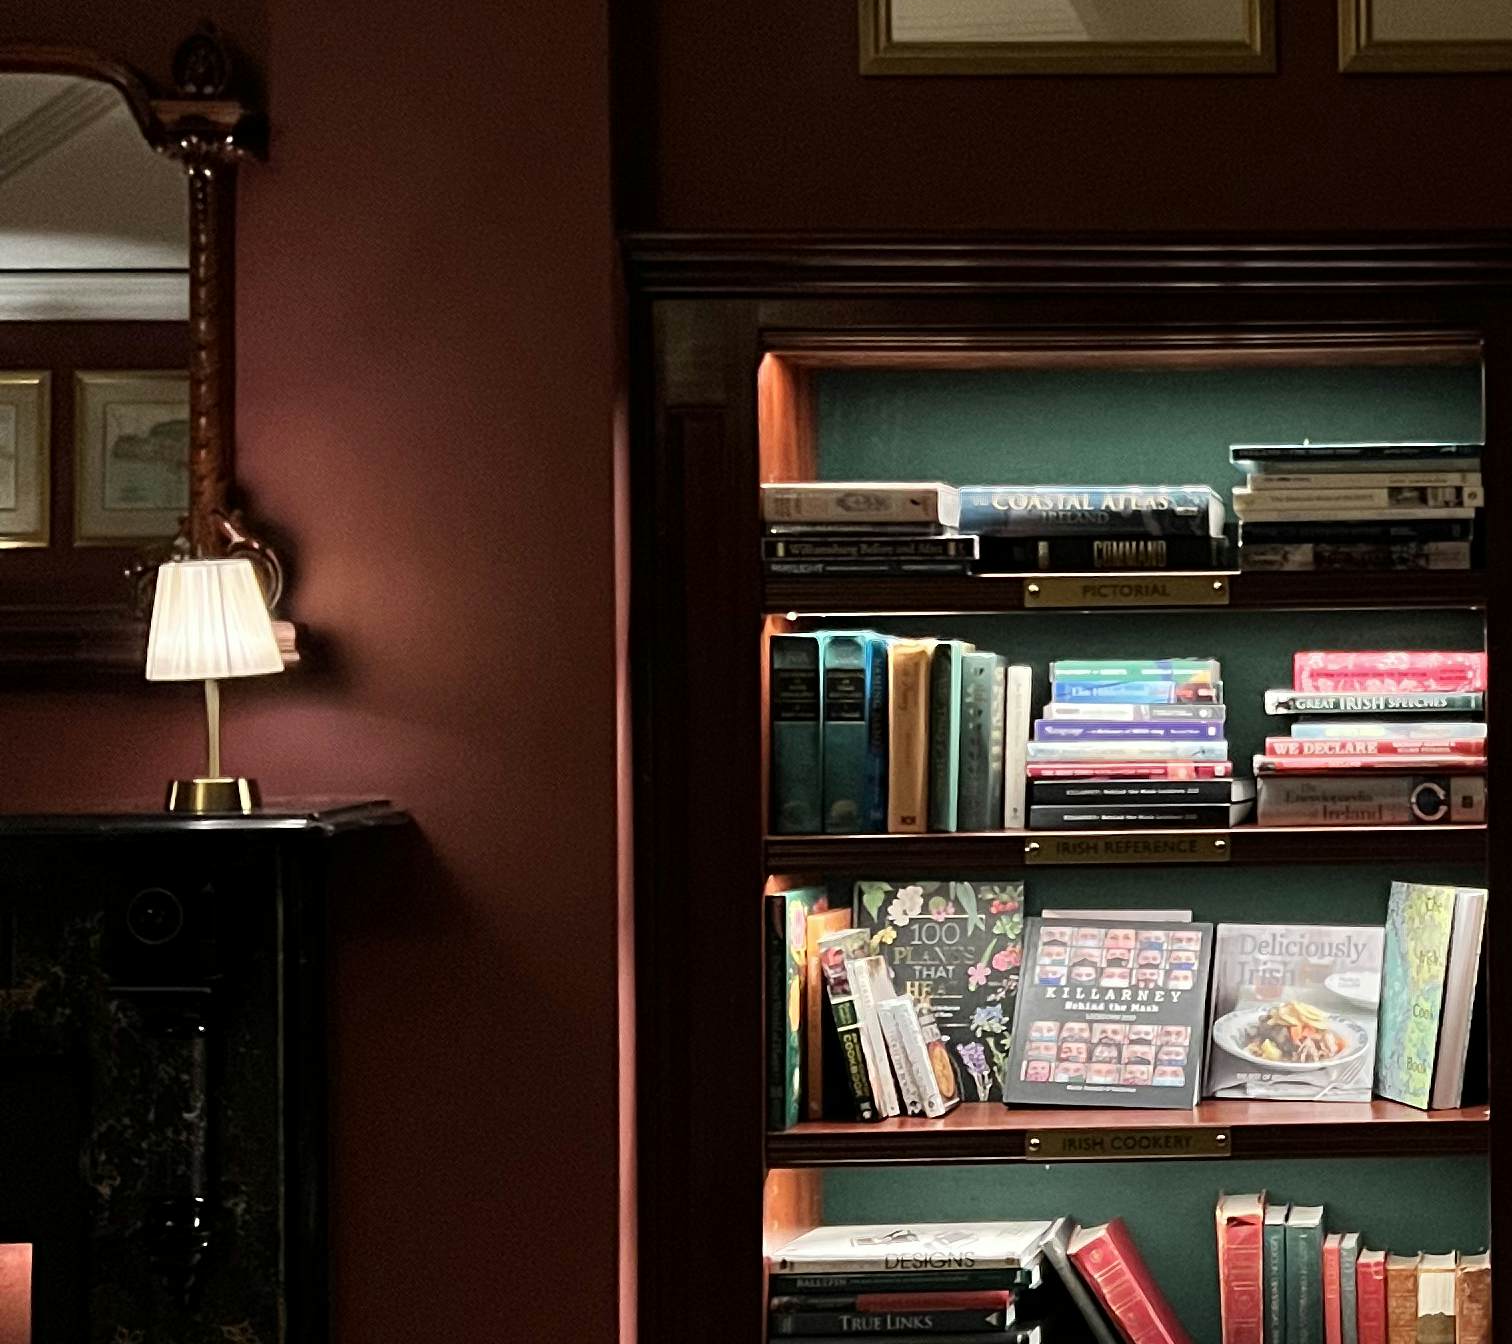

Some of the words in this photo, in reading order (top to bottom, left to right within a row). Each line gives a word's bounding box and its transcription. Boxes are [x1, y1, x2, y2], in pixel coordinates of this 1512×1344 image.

[992, 493, 1094, 511] COASTAL
[1100, 493, 1168, 510] ATLAS
[1042, 511, 1110, 524] IRELAND
[1093, 540, 1166, 567] COMMAND
[1082, 584, 1170, 597] PICTORIAL
[1295, 697, 1335, 709] GREAT
[1339, 696, 1384, 710] IRISH
[1388, 696, 1447, 708] SPEECHES
[1273, 742, 1299, 754] WE
[1302, 742, 1377, 754] DECLARE
[1323, 805, 1383, 820] Ireland
[1056, 841, 1098, 855] IRISH
[1104, 840, 1197, 854] REFERENCE
[910, 923, 960, 945] 100
[894, 947, 976, 965] PLANTS
[1239, 932, 1367, 964] Deliciously
[914, 965, 954, 978] THAT
[1239, 960, 1296, 986] Irish
[1045, 987, 1182, 1003] KILLARNEY
[1064, 1001, 1105, 1011] Behind
[1108, 1003, 1127, 1012] the
[1131, 1003, 1159, 1013] Mask
[1412, 1004, 1434, 1020] Cook
[843, 1034, 864, 1097] COOKBOOK
[1406, 1056, 1428, 1073] Book
[1062, 1136, 1105, 1151] IRISH
[1111, 1135, 1192, 1150] COOKERY
[884, 1252, 976, 1269] DESIGNS
[839, 1315, 881, 1331] TRUE
[886, 1315, 933, 1330] LINKS
